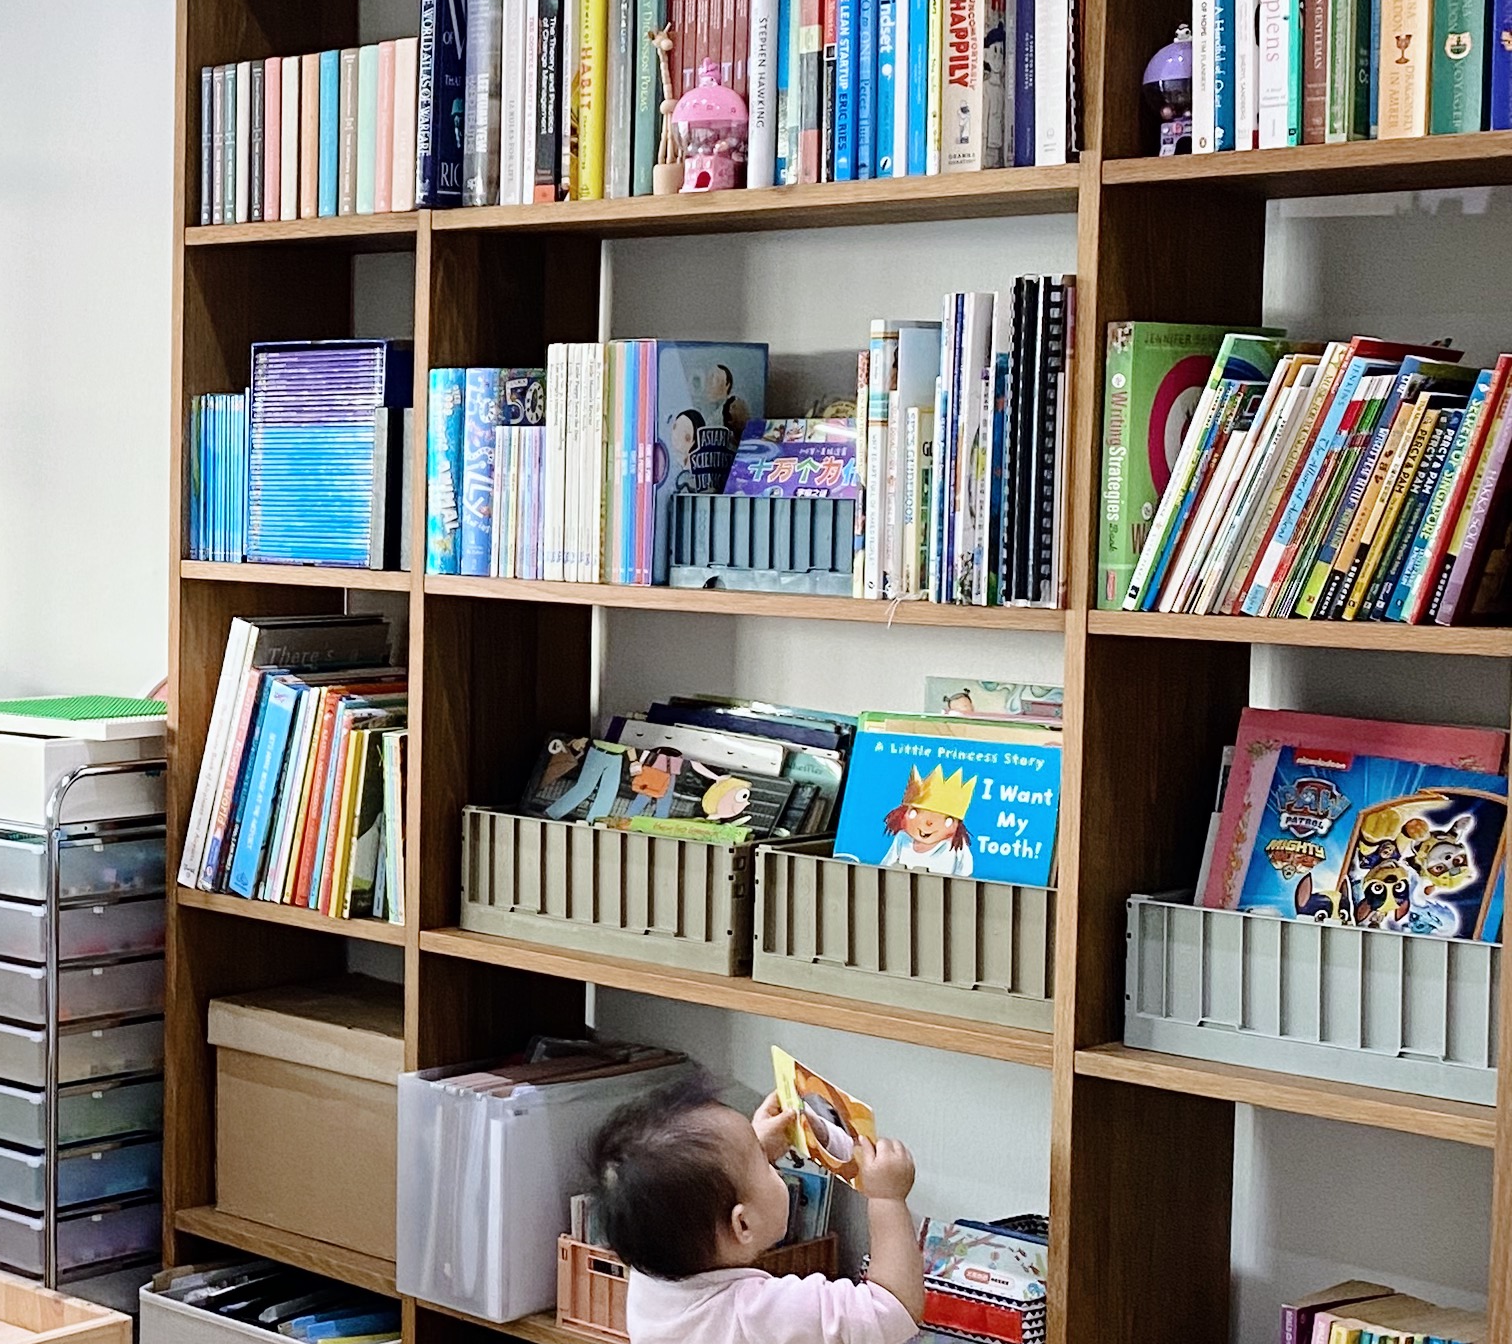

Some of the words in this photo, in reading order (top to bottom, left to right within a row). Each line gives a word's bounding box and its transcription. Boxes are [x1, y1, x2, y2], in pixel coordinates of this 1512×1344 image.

[422, 8, 434, 50] WORLD
[548, 16, 557, 34] The
[838, 5, 850, 36] LEAN
[1200, 14, 1208, 37] HOPE
[540, 28, 550, 68] Change
[548, 38, 556, 70] Theory
[641, 11, 652, 72] DICKINSON
[758, 17, 768, 68] STEPHEN
[859, 31, 871, 62] ONE
[1314, 6, 1324, 70] GENTLEMAN
[420, 52, 432, 88] ATLAS
[580, 46, 593, 111] HABIT
[838, 38, 850, 90] STARTUP
[476, 74, 488, 92] LEE
[548, 72, 556, 92] and
[640, 75, 651, 112] POEMS
[858, 78, 870, 110] Peter
[1404, 64, 1415, 132] DRAGONFLY
[1452, 60, 1464, 128] VOYAGER
[540, 70, 549, 134] Management
[546, 93, 556, 134] Practice
[756, 72, 767, 128] HAWKING
[838, 94, 848, 122] ERIC
[1388, 88, 1399, 128] AMBER
[418, 106, 432, 156] WARFARE
[476, 126, 488, 152] YEW
[508, 110, 516, 140] RULES
[837, 124, 848, 150] RIES
[504, 376, 546, 424] 50
[1312, 373, 1334, 405] MUSIC
[1336, 363, 1361, 408] JENKINS
[1306, 402, 1321, 421] FOR
[1454, 396, 1484, 450] SECRETS
[700, 430, 726, 448] ASIAN
[1293, 417, 1315, 452] YOUNG
[1312, 436, 1331, 461] The
[1407, 428, 1428, 463] PERCY
[1423, 427, 1445, 462] PERCY
[1435, 428, 1456, 462] PERCY
[870, 464, 878, 478] ART
[1274, 448, 1302, 494] CHILDREN
[1299, 459, 1320, 490] Allure
[1403, 461, 1415, 471] &
[1420, 460, 1431, 471] &
[1431, 460, 1443, 471] &
[1447, 448, 1464, 469] OF
[438, 460, 460, 534] ANIMAL
[870, 480, 878, 499] FULL
[905, 450, 916, 525] GUIDEBOOK
[1102, 446, 1127, 522] Strategies
[1394, 470, 1411, 495] PAM
[1410, 470, 1427, 495] PAM
[1421, 470, 1438, 495] PAM
[1473, 469, 1499, 517] HAKKA
[1418, 468, 1456, 542] SINGAPORE
[1462, 506, 1486, 550] SOUL
[268, 645, 334, 666] There's
[874, 741, 884, 752] A
[890, 742, 932, 758] Little
[937, 746, 998, 764] Princess
[1003, 752, 1046, 772] Story
[216, 787, 234, 826] World
[981, 778, 994, 801] I
[999, 784, 1054, 806] Want
[1276, 784, 1352, 820] PAW
[996, 810, 1030, 837] My
[1285, 816, 1324, 830] PATROL
[977, 836, 1042, 860] Tooth!
[1265, 838, 1326, 860] MIGHTY
